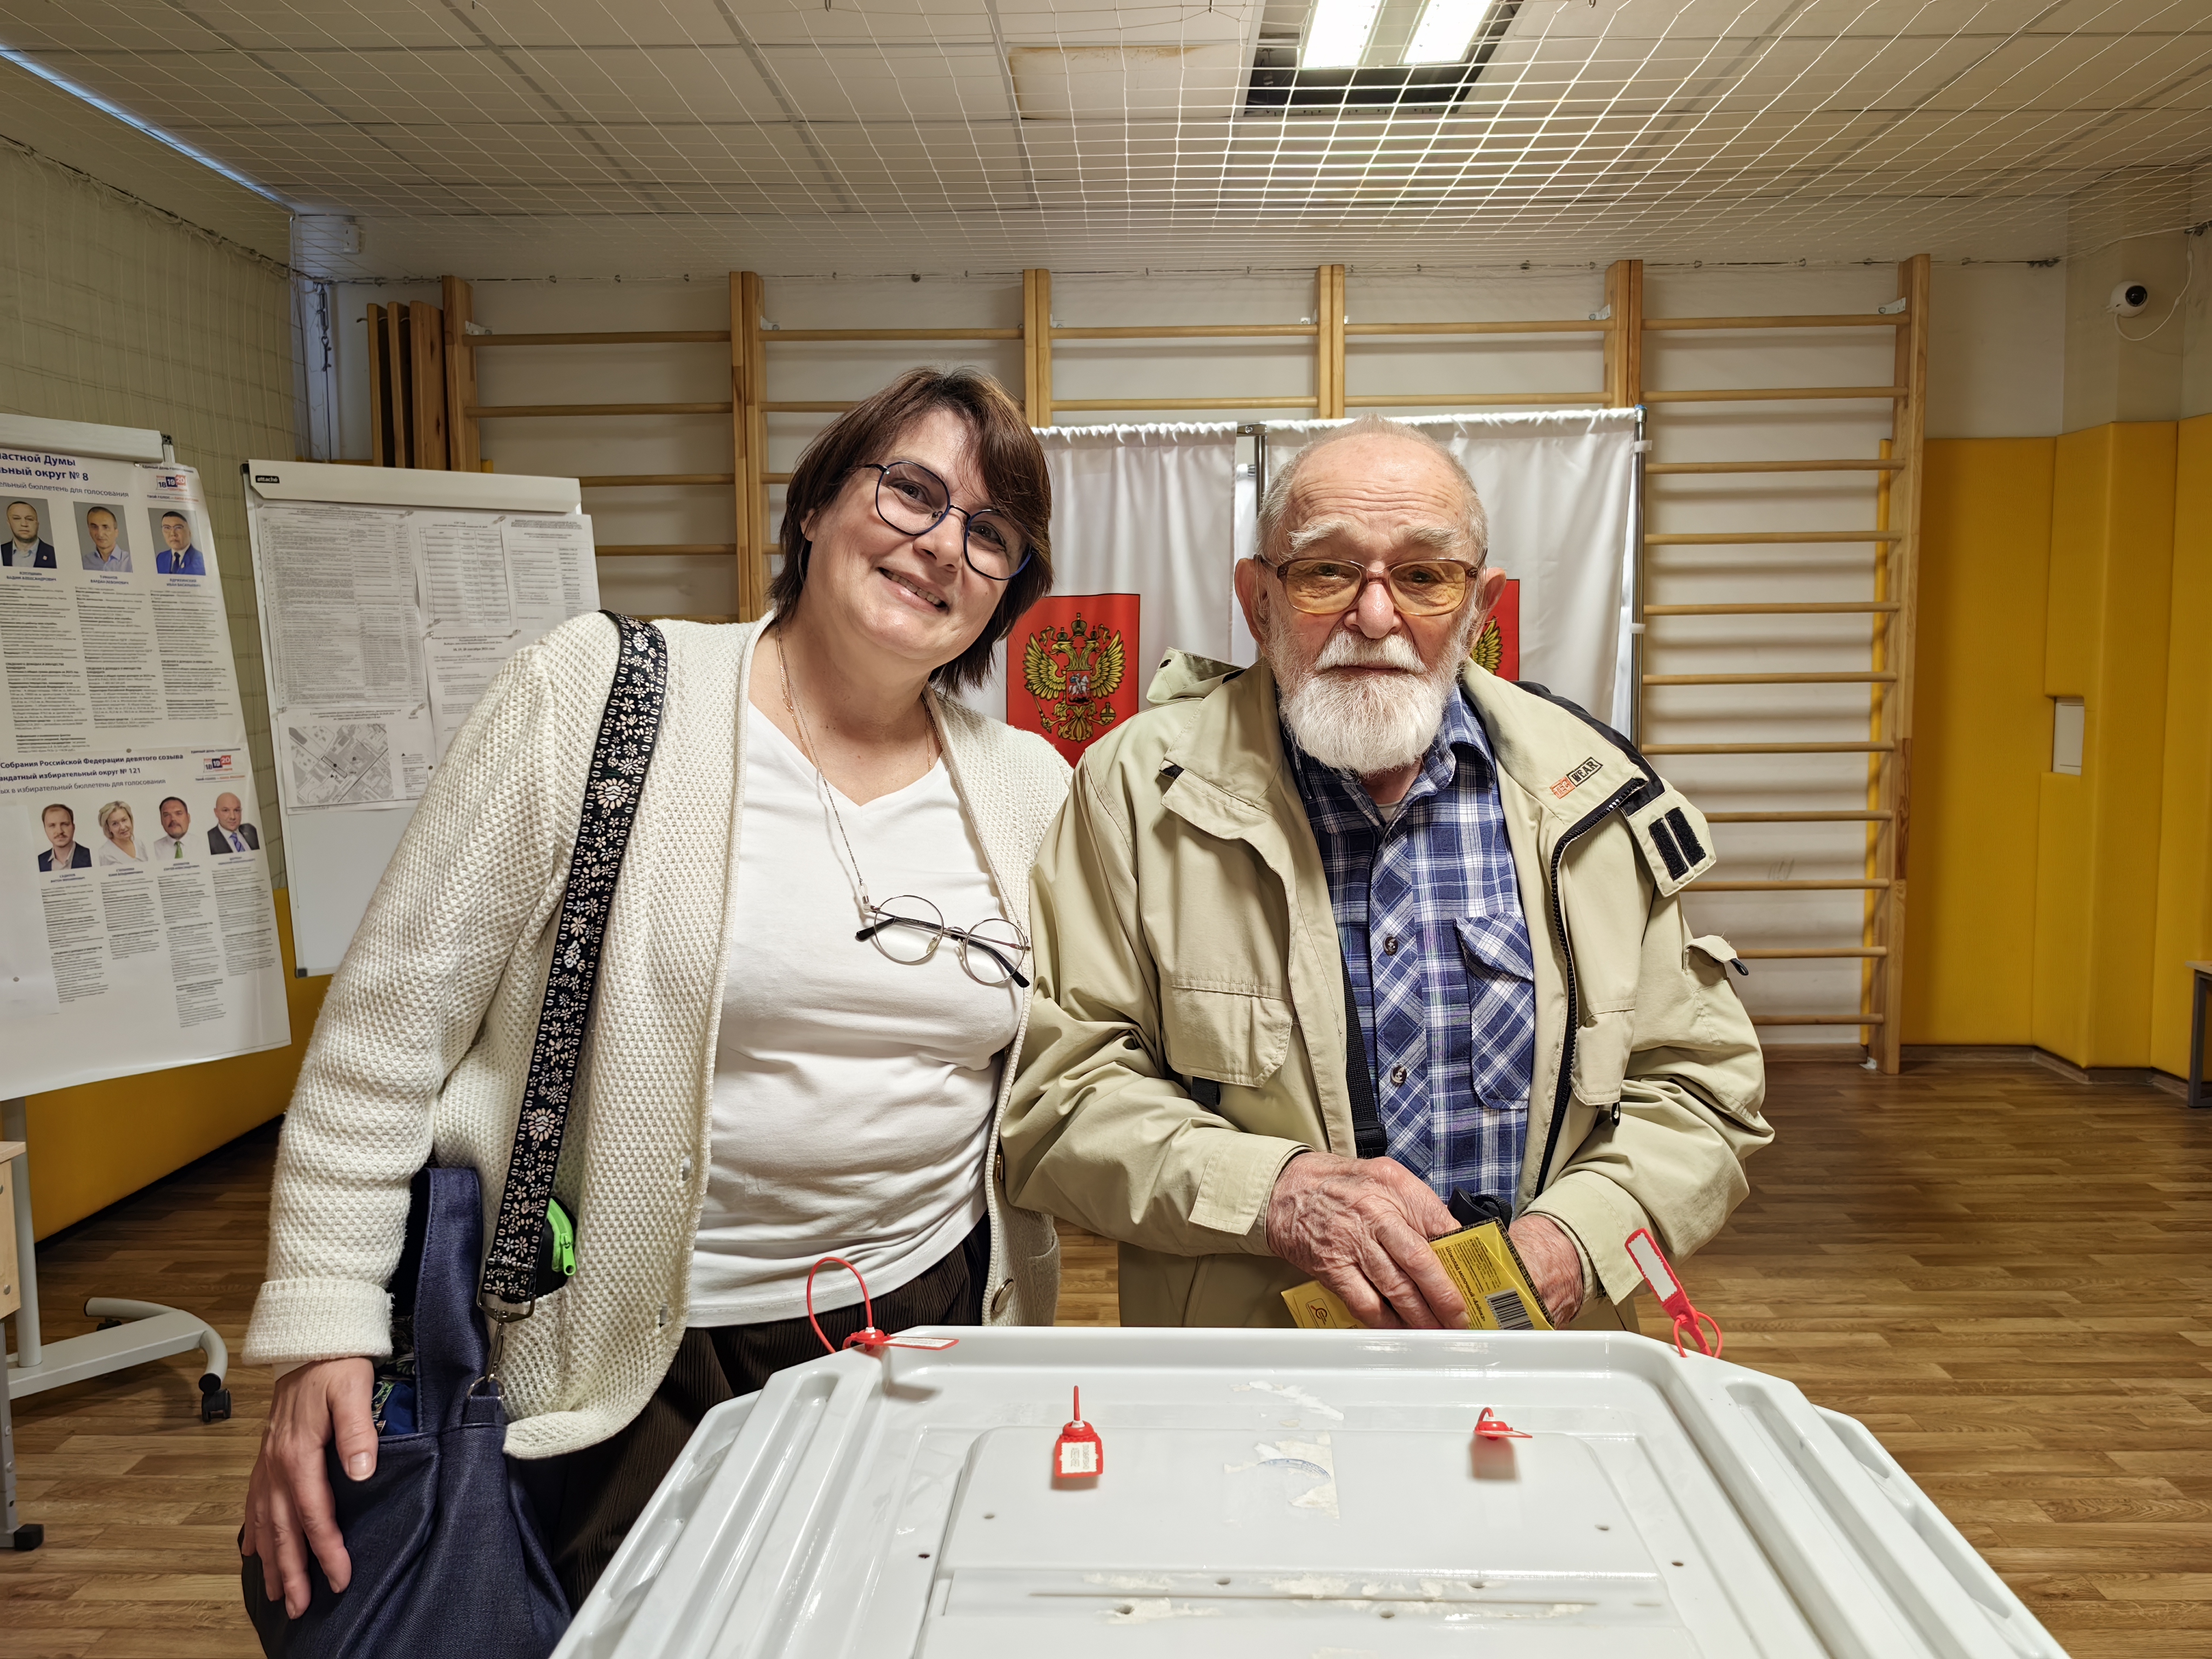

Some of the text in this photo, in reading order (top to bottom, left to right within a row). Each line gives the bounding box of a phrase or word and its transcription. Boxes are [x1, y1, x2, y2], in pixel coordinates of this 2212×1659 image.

[44, 455, 76, 466] Думы
[0, 467, 89, 481] ьный округ № 8
[84, 489, 129, 497] голосования
[1, 761, 38, 769] Собрания
[83, 757, 125, 765] Федерации
[39, 770, 97, 779] избирательный
[1571, 760, 1599, 783] WEAR
[17, 783, 73, 793] избирательный
[1445, 1246, 1460, 1271] Шоколад
[1458, 1271, 1475, 1297] молочный
